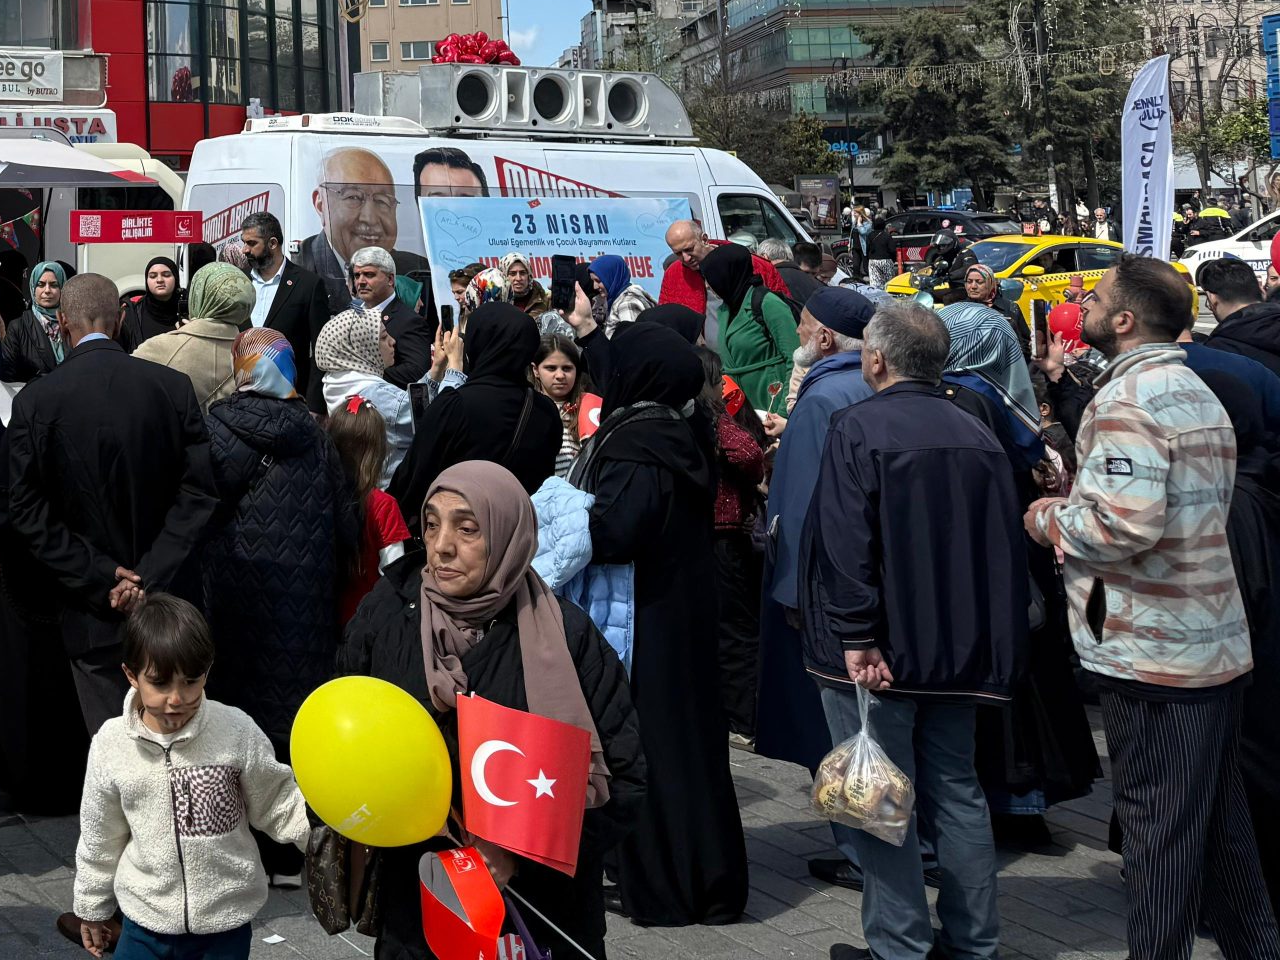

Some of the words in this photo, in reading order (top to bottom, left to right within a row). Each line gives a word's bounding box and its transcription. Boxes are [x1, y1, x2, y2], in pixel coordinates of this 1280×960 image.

[20, 58, 45, 81] go
[27, 87, 35, 96] by
[34, 116, 107, 135] USTA
[512, 214, 536, 235] 23
[547, 213, 610, 235] NİSAN
[488, 238, 510, 246] Ulusal
[511, 238, 545, 248] Egemenlik
[555, 238, 577, 248] Çocuk
